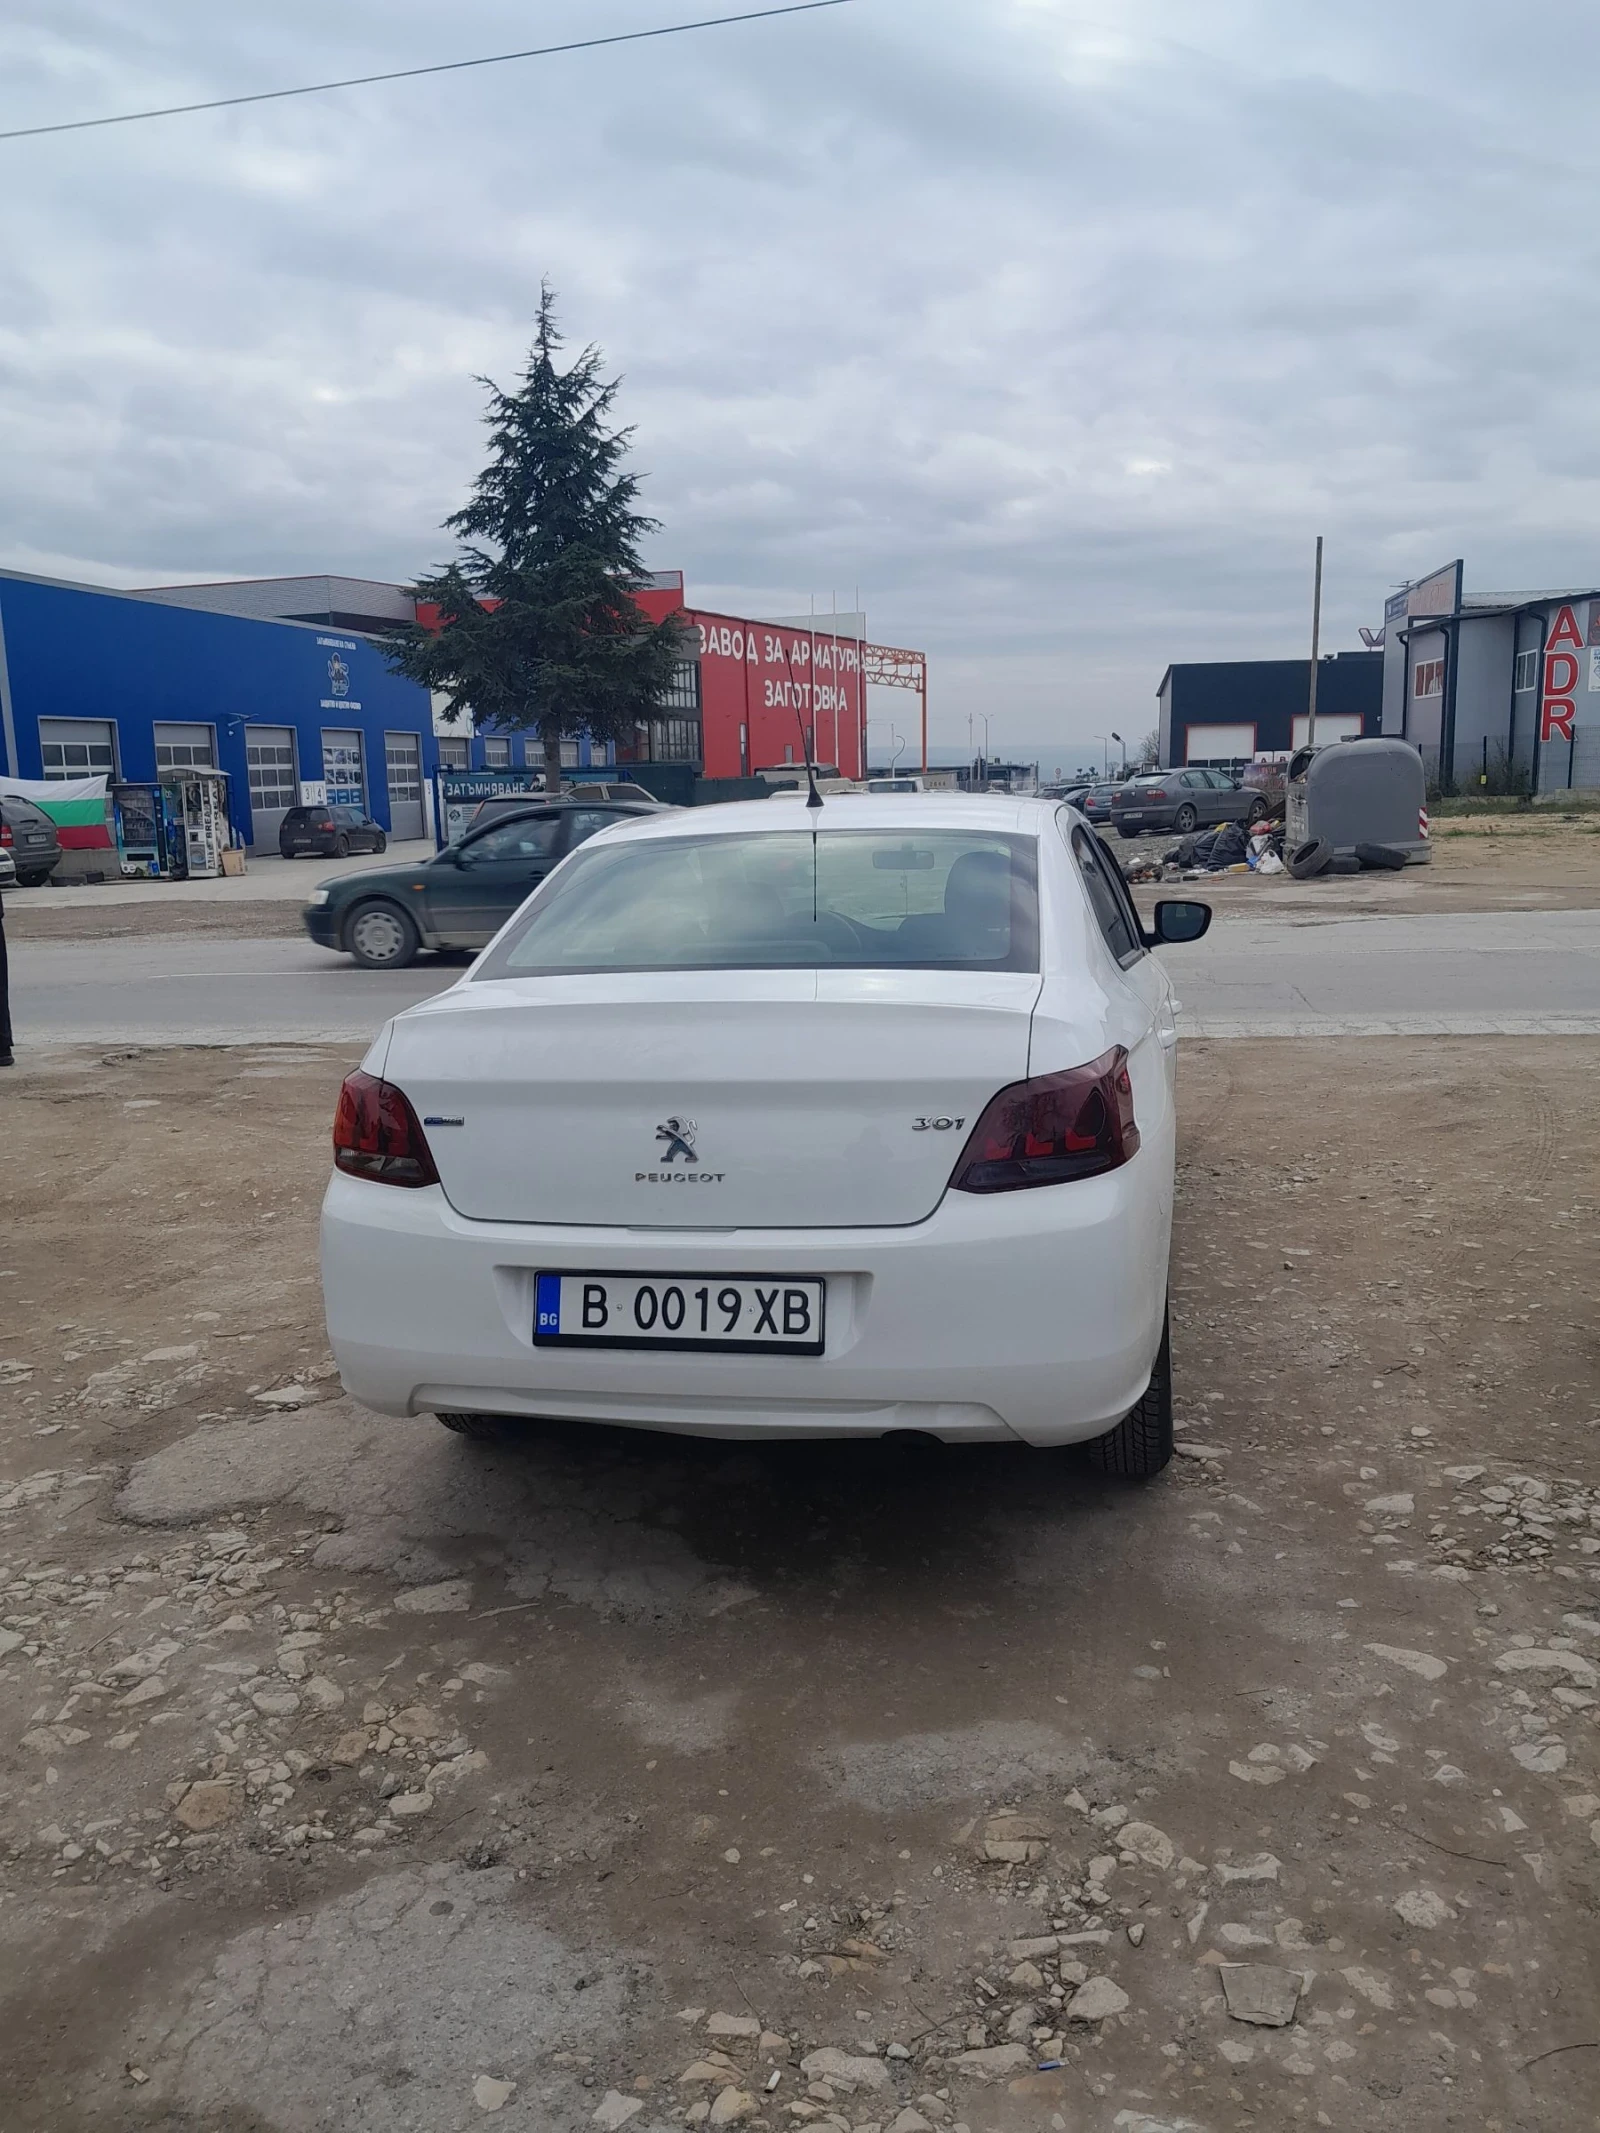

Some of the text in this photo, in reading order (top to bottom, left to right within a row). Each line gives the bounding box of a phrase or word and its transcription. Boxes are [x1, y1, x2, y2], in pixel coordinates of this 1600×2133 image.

[697, 623, 759, 666] ЗАВОД
[764, 634, 785, 664] ЗА
[1540, 604, 1586, 743] ADR
[764, 679, 848, 712] ЗАГОТОВКА
[446, 782, 526, 797] ЗАТЪМНЯВАНЕ
[911, 1114, 966, 1131] 301
[634, 1172, 726, 1183] PEUGEOT
[539, 1312, 558, 1327] BG
[582, 1284, 609, 1329] B
[633, 1285, 742, 1333] 0019
